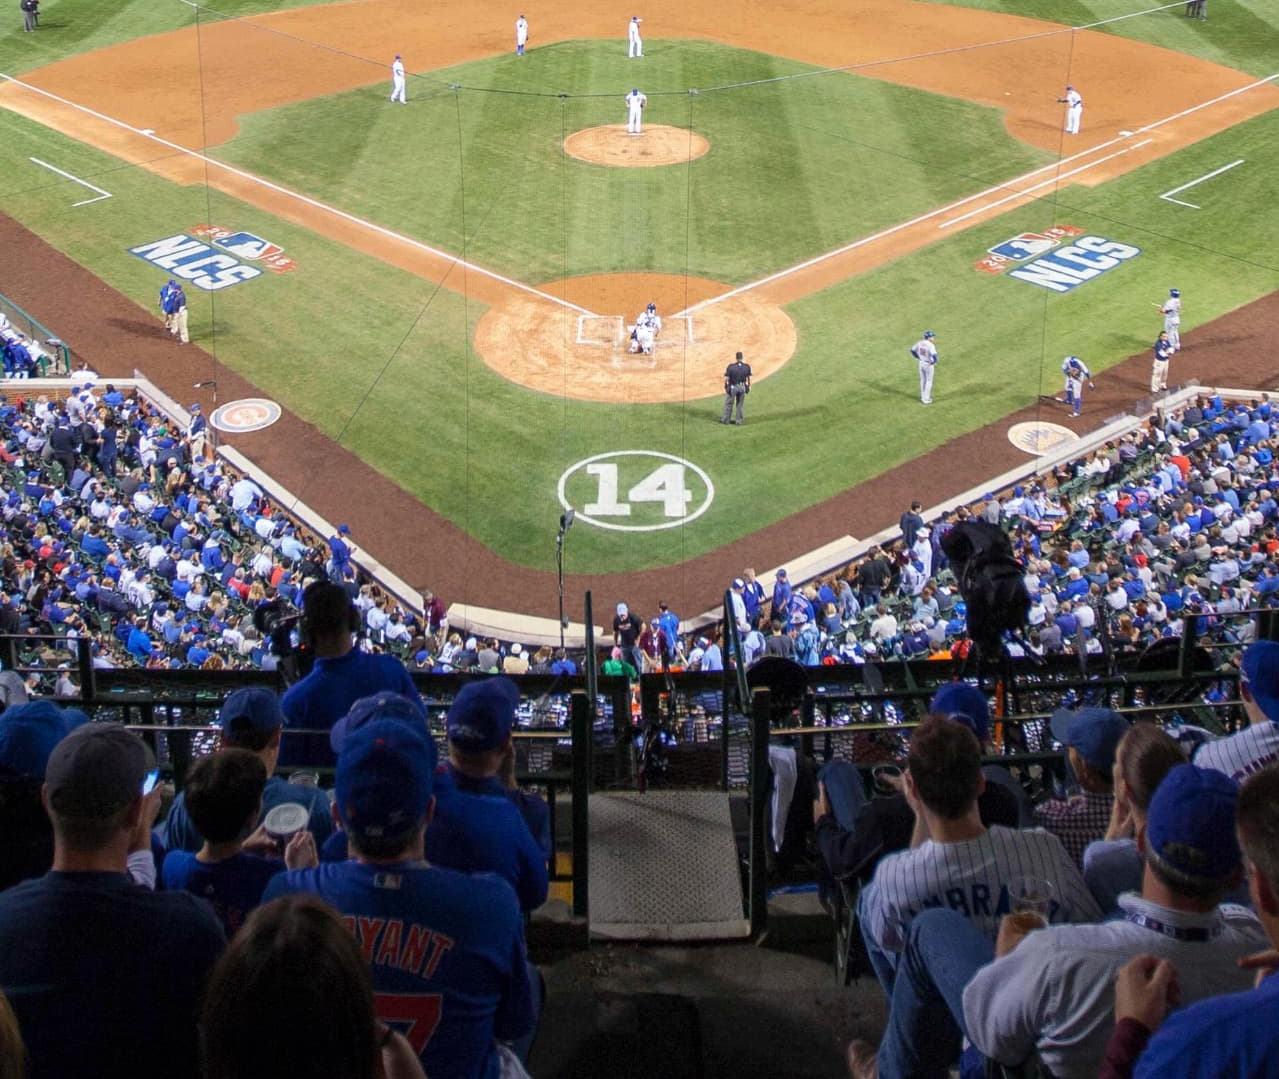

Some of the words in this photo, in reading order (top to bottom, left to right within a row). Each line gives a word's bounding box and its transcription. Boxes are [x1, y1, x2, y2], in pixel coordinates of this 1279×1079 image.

[129, 233, 264, 291] NLCS
[1009, 235, 1141, 293] NLCS
[584, 463, 692, 517] 14
